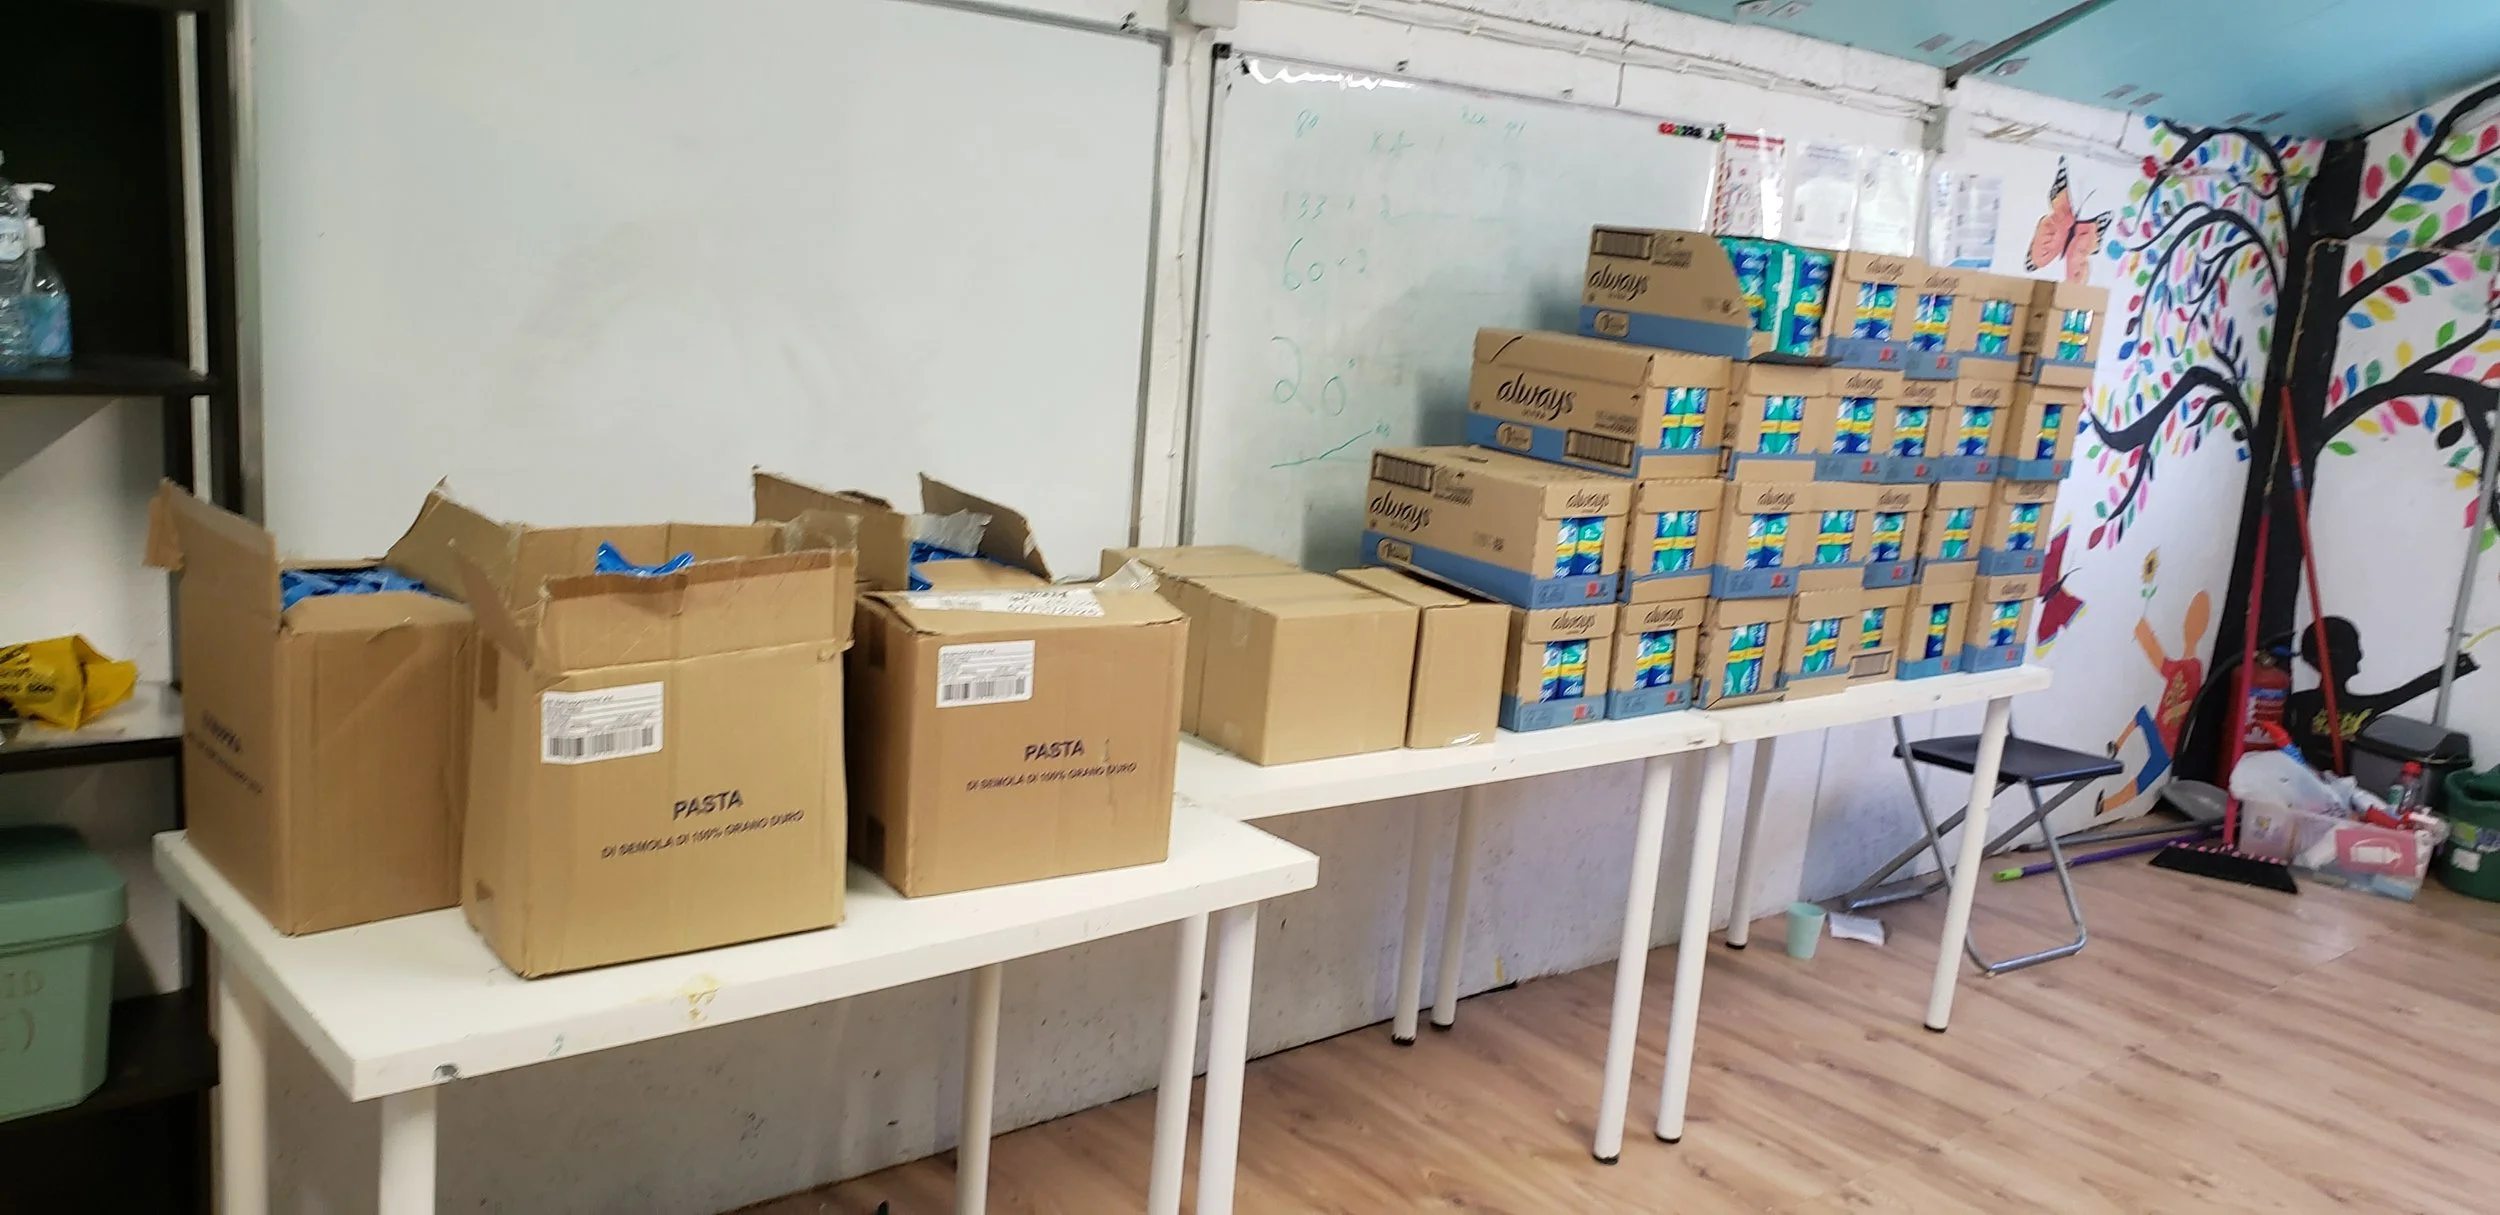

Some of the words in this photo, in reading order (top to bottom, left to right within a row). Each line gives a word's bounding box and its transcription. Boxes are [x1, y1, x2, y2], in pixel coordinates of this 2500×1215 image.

[1587, 263, 1649, 301] always
[1497, 372, 1578, 421] always
[1370, 489, 1433, 533] always
[1566, 488, 1610, 513] always
[1551, 611, 1597, 634] always
[1643, 605, 1685, 628] always
[1024, 739, 1085, 763] PASTA
[966, 780, 978, 792] DI
[979, 776, 1024, 790] SEMOLA
[1026, 774, 1038, 784] DI
[1068, 766, 1105, 779] GRANO
[1106, 761, 1138, 775] DURO
[672, 788, 745, 821] PASTA
[601, 845, 617, 860] DI
[619, 836, 674, 856] SEMOLA
[675, 833, 690, 846] DI
[692, 826, 723, 844] 100%
[724, 817, 769, 836] GRANO
[770, 809, 805, 828] DURO
